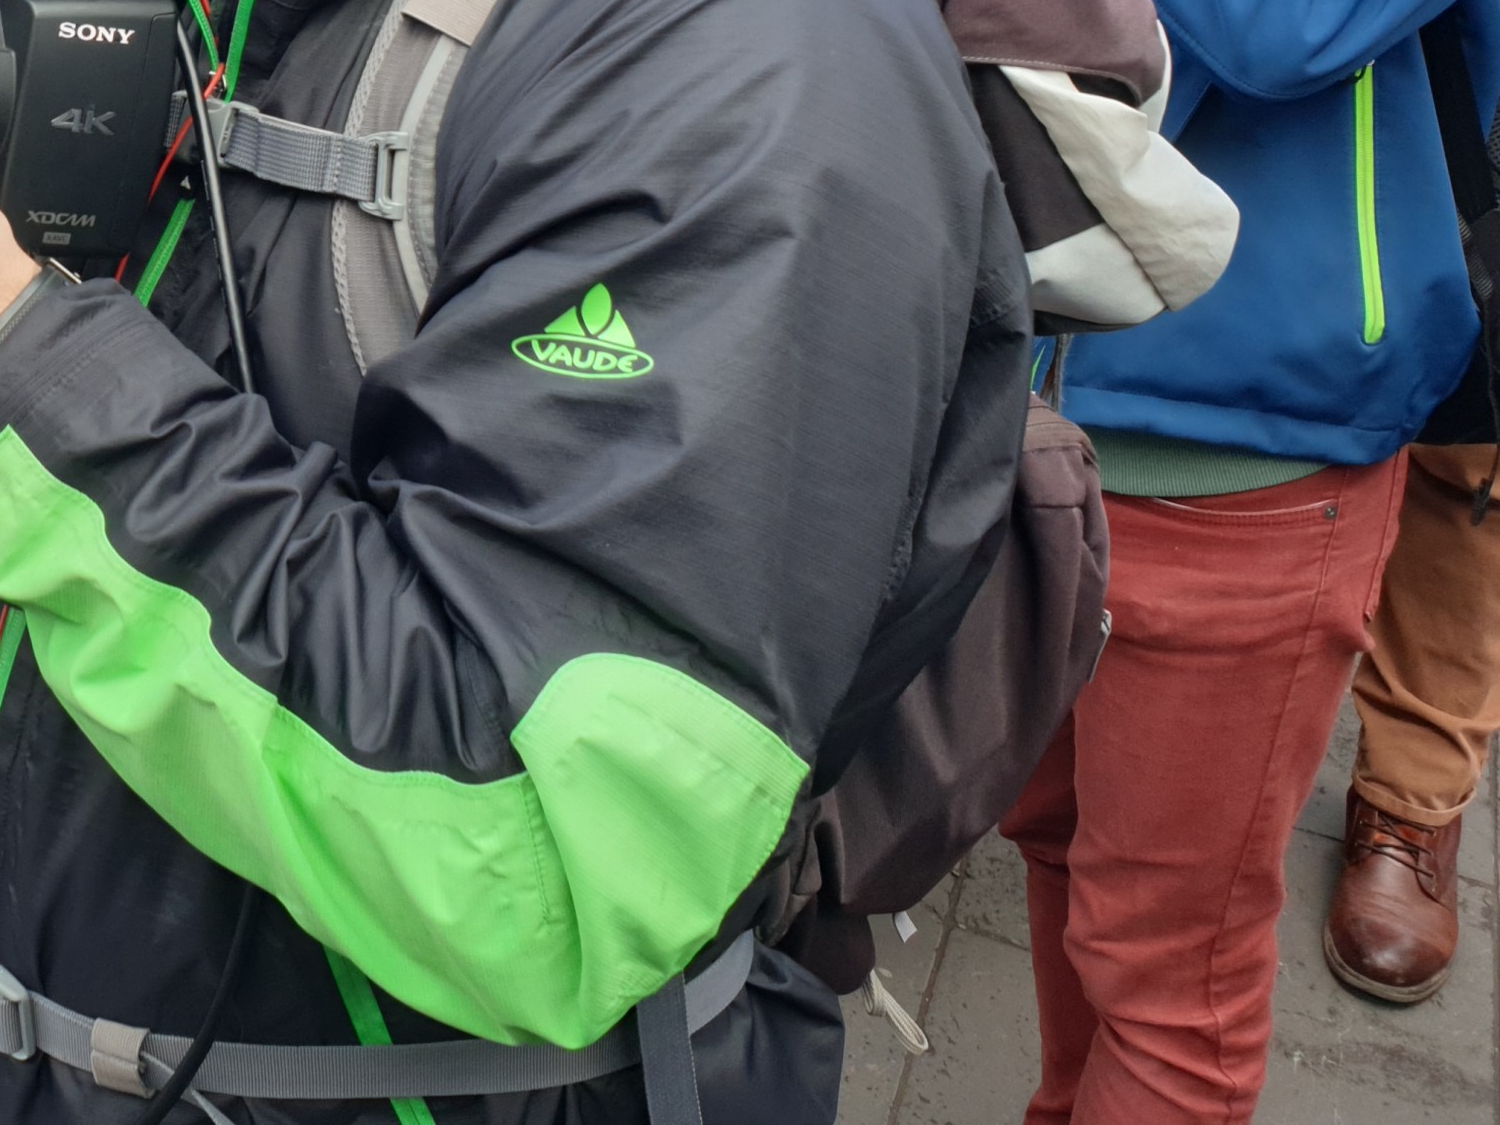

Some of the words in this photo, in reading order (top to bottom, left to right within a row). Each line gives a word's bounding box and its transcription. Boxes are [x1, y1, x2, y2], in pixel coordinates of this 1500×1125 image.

[58, 22, 135, 44] SONY
[51, 108, 116, 135] 4K
[531, 338, 638, 373] VAUDE
